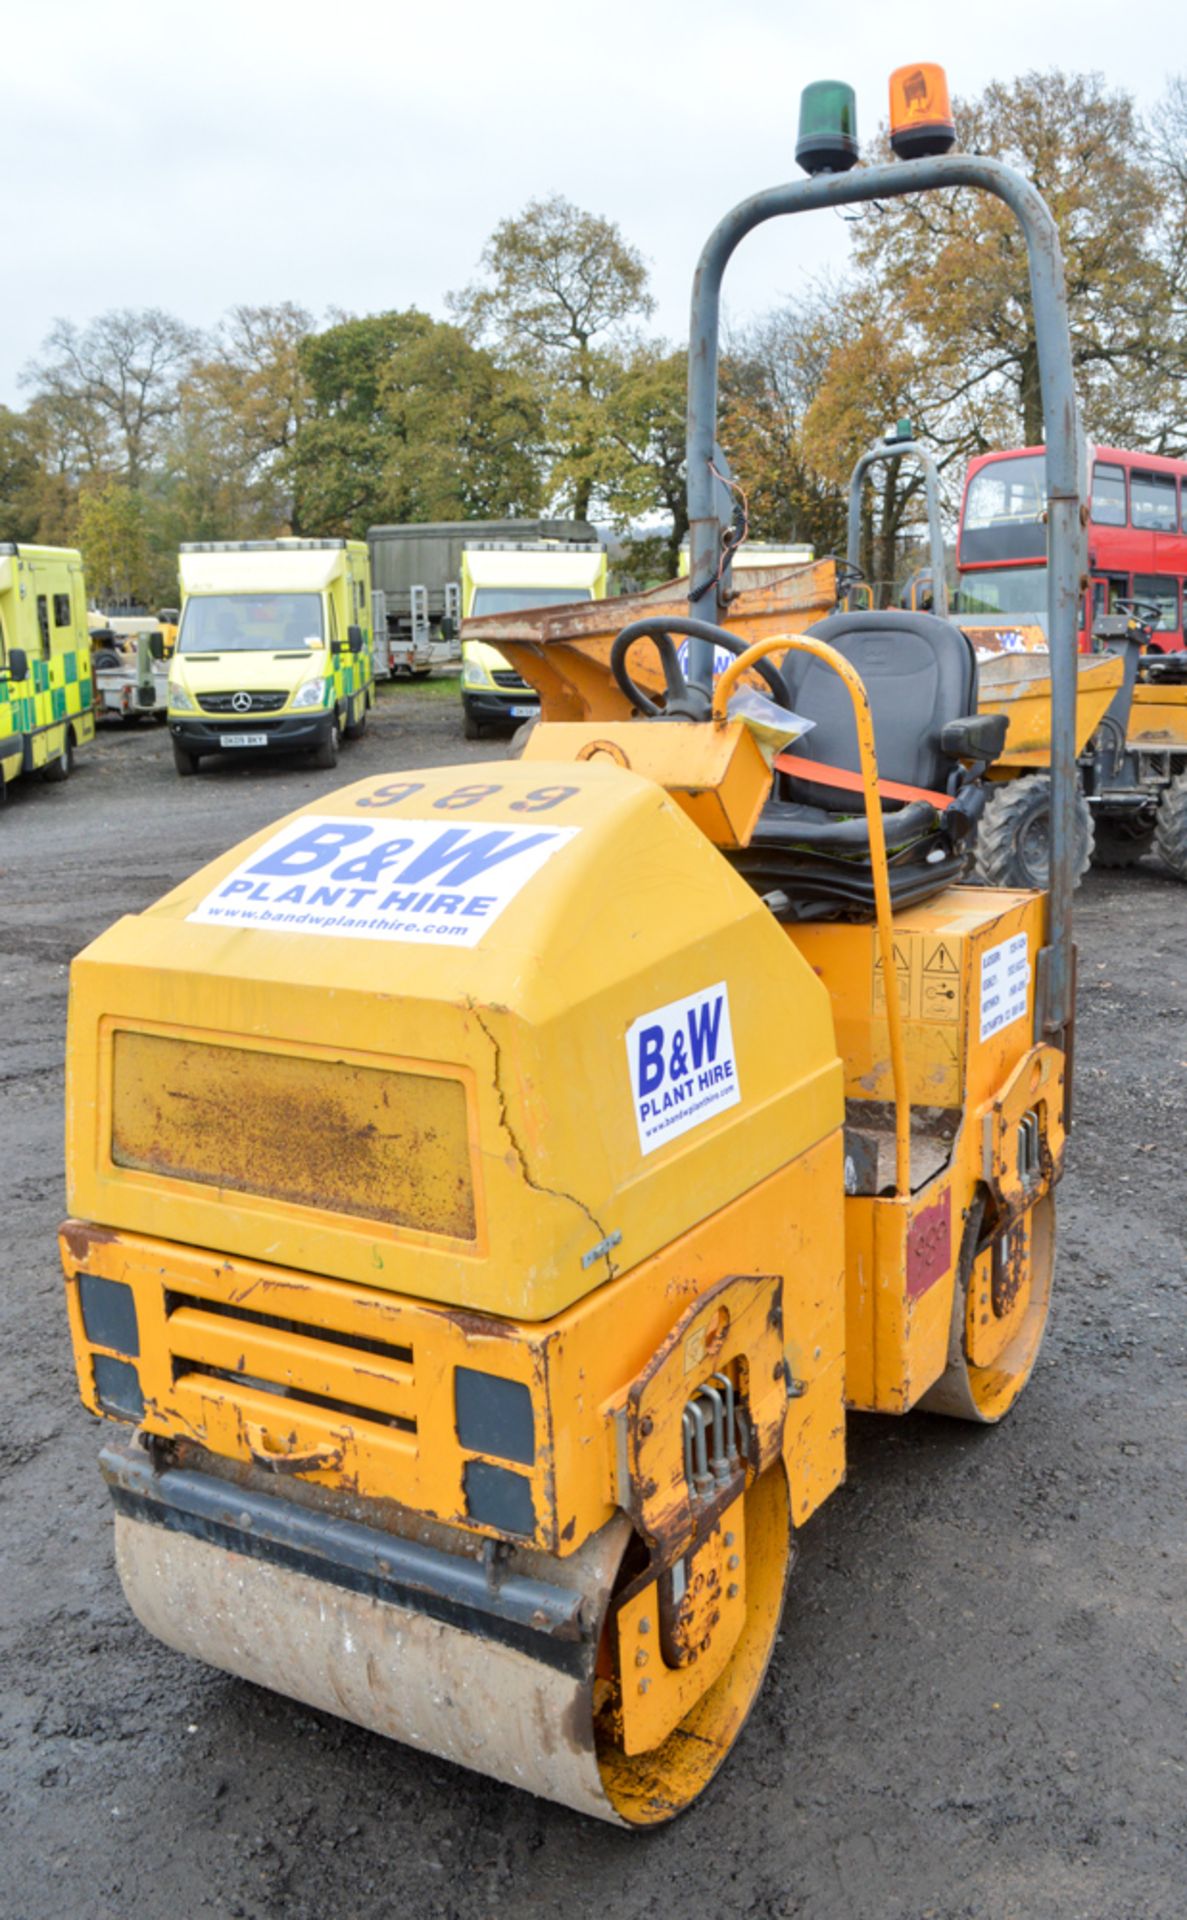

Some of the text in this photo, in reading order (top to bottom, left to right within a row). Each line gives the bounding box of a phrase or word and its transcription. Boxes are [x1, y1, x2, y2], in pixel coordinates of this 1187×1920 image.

[355, 782, 580, 812] 989
[247, 823, 558, 888] B&W
[208, 907, 469, 934] www.bandwplanthire.com
[219, 879, 498, 917] PLANT HIRE
[638, 995, 724, 1099] B&W
[639, 1058, 733, 1122] PLANT HIRE
[645, 1084, 735, 1137] www.bandwplanthire.com
